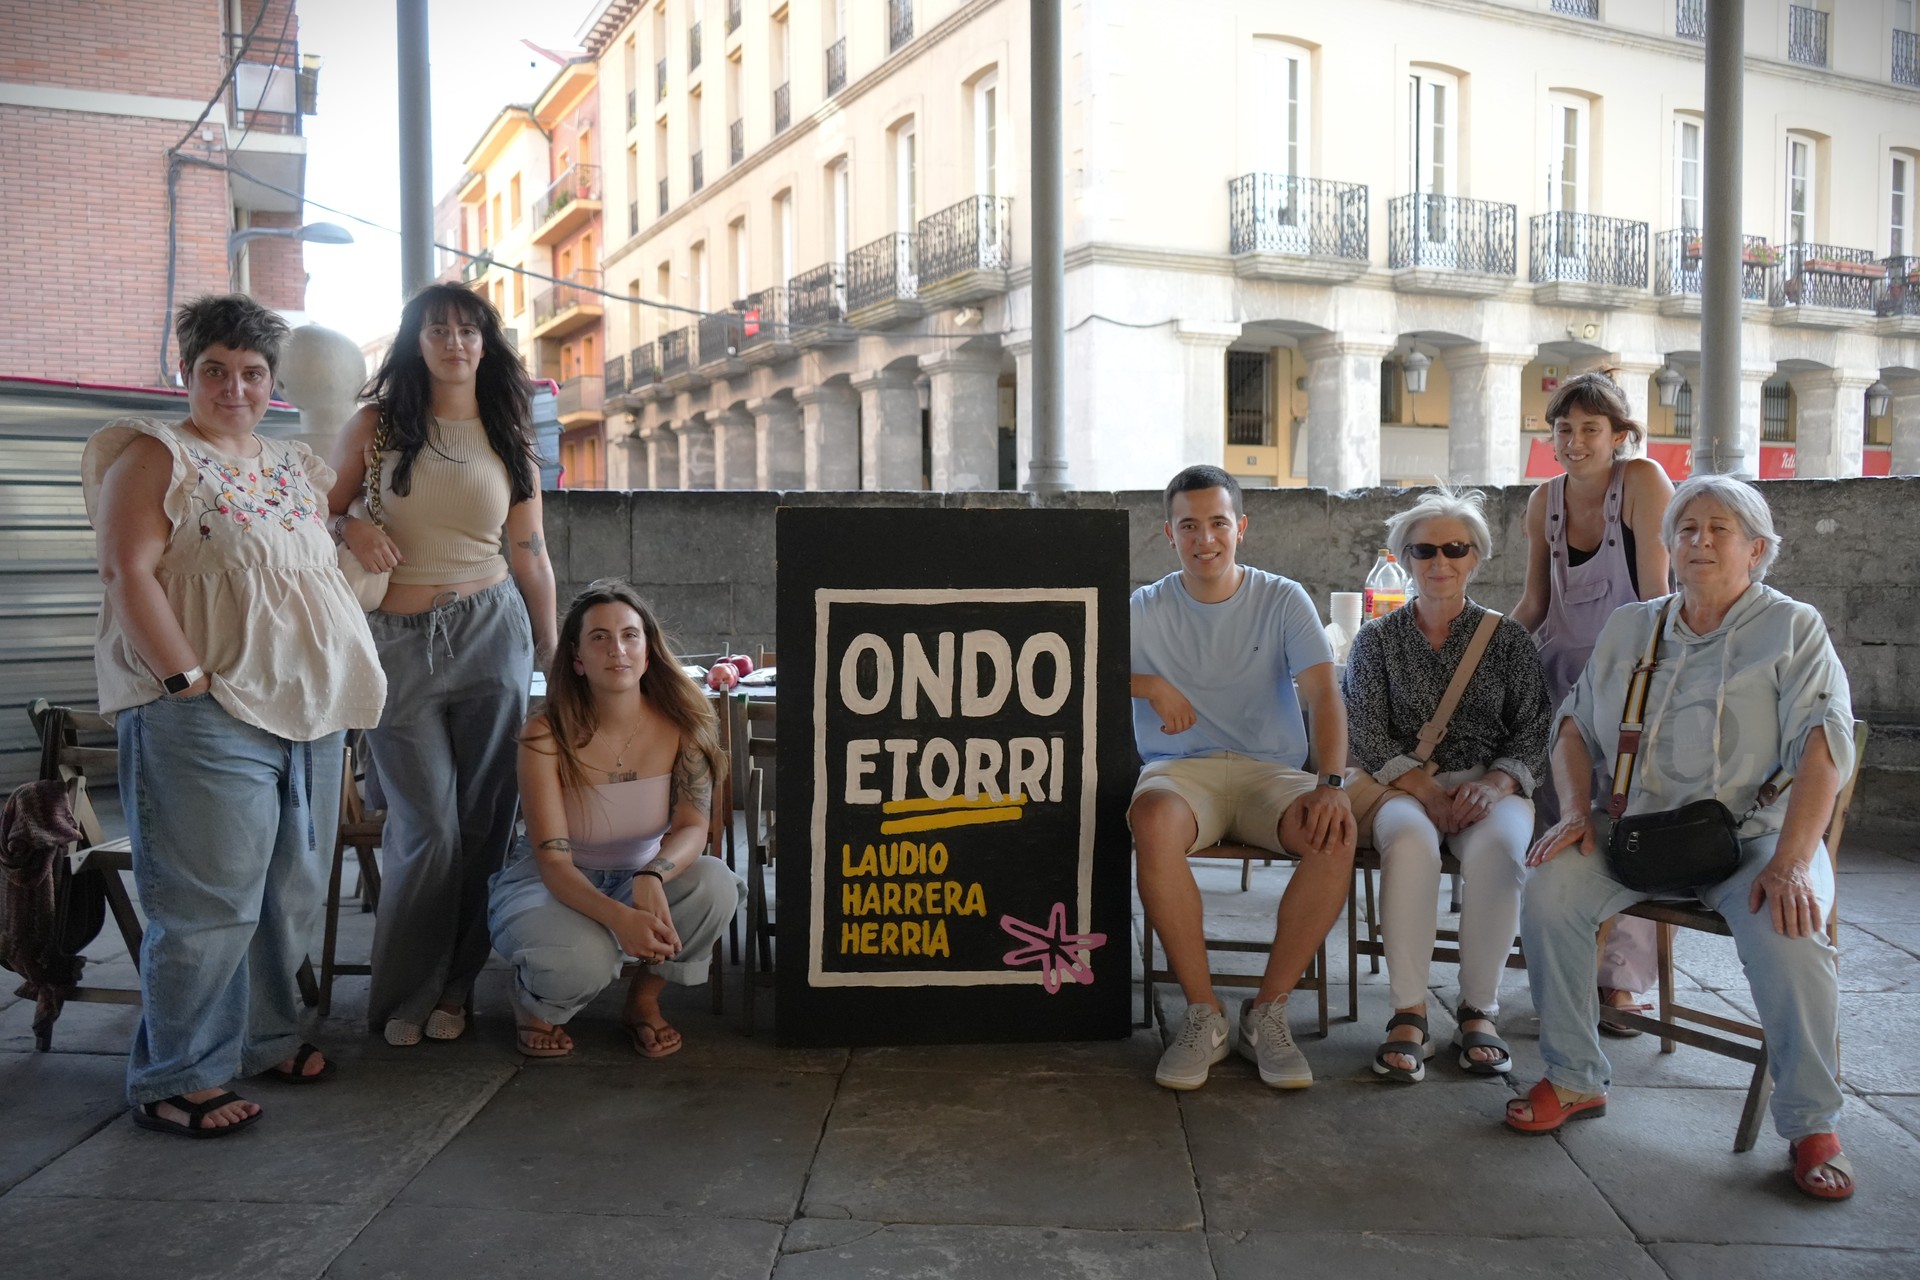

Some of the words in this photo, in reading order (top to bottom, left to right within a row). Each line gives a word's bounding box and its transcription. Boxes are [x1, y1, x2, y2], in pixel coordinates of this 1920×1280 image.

[840, 630, 1072, 719] ONDO
[845, 737, 1064, 804] ETORRI
[842, 841, 949, 878] LAUDIO
[842, 881, 987, 917] HARRERA
[840, 919, 949, 958] HERRIA
